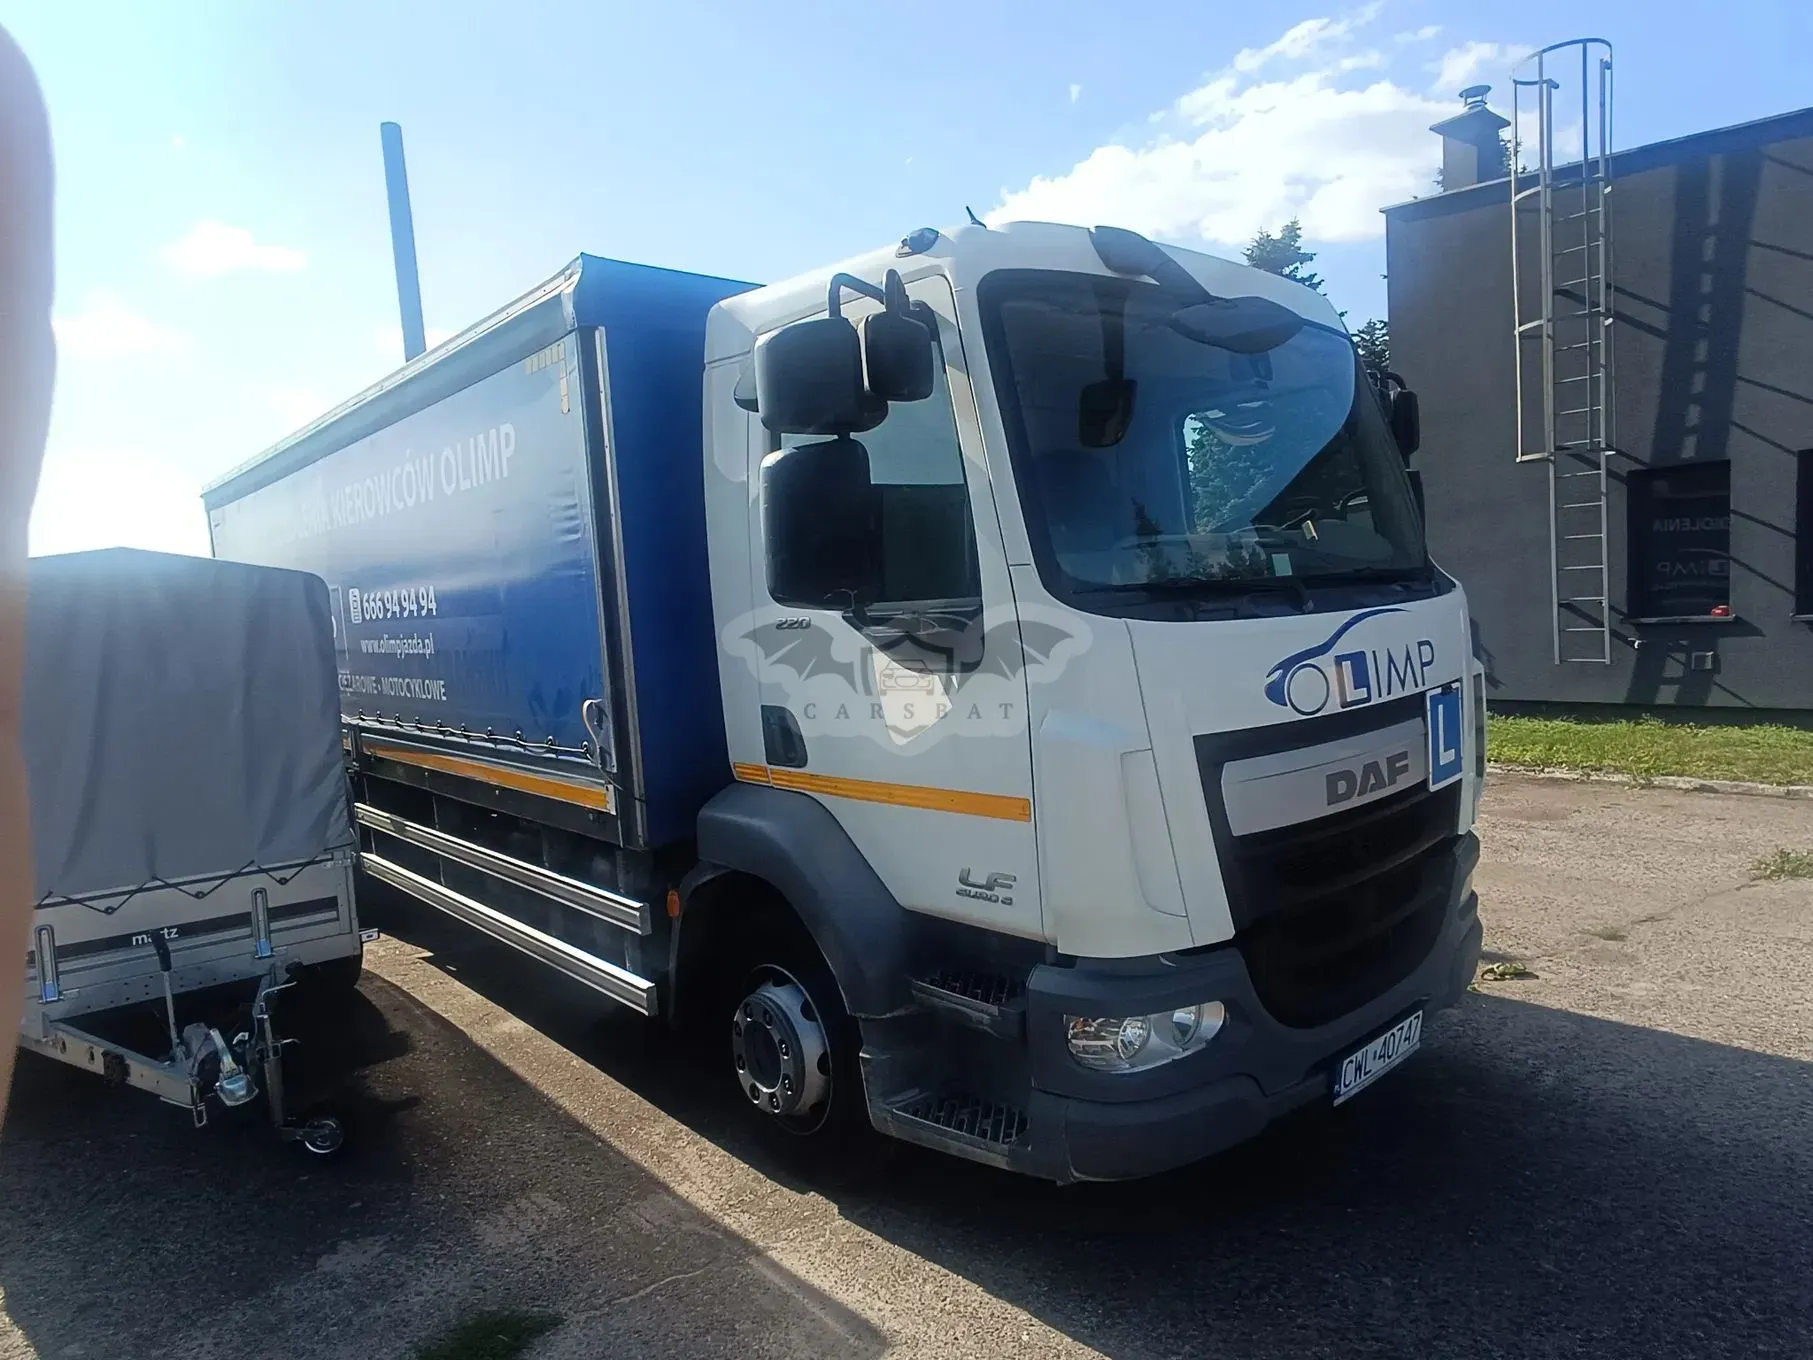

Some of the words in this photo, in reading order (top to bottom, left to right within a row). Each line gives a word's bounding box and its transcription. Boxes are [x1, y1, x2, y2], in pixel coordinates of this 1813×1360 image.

[333, 449, 435, 529] KIEROWCÓW
[440, 422, 516, 496] OLIMP
[362, 592, 384, 620] 666
[384, 590, 401, 618] 94
[401, 588, 418, 618] 94
[419, 585, 437, 616] 94
[776, 616, 811, 630] 220
[360, 632, 434, 659] www.olimpjazda.pl
[381, 677, 447, 700] MOTOCYKLOWE
[1287, 640, 1435, 717] OLIMP
[1438, 703, 1455, 766] L
[1326, 751, 1409, 807] DAF
[959, 866, 1017, 892] LF
[132, 927, 179, 946] mtz
[1377, 1015, 1421, 1065] 40747
